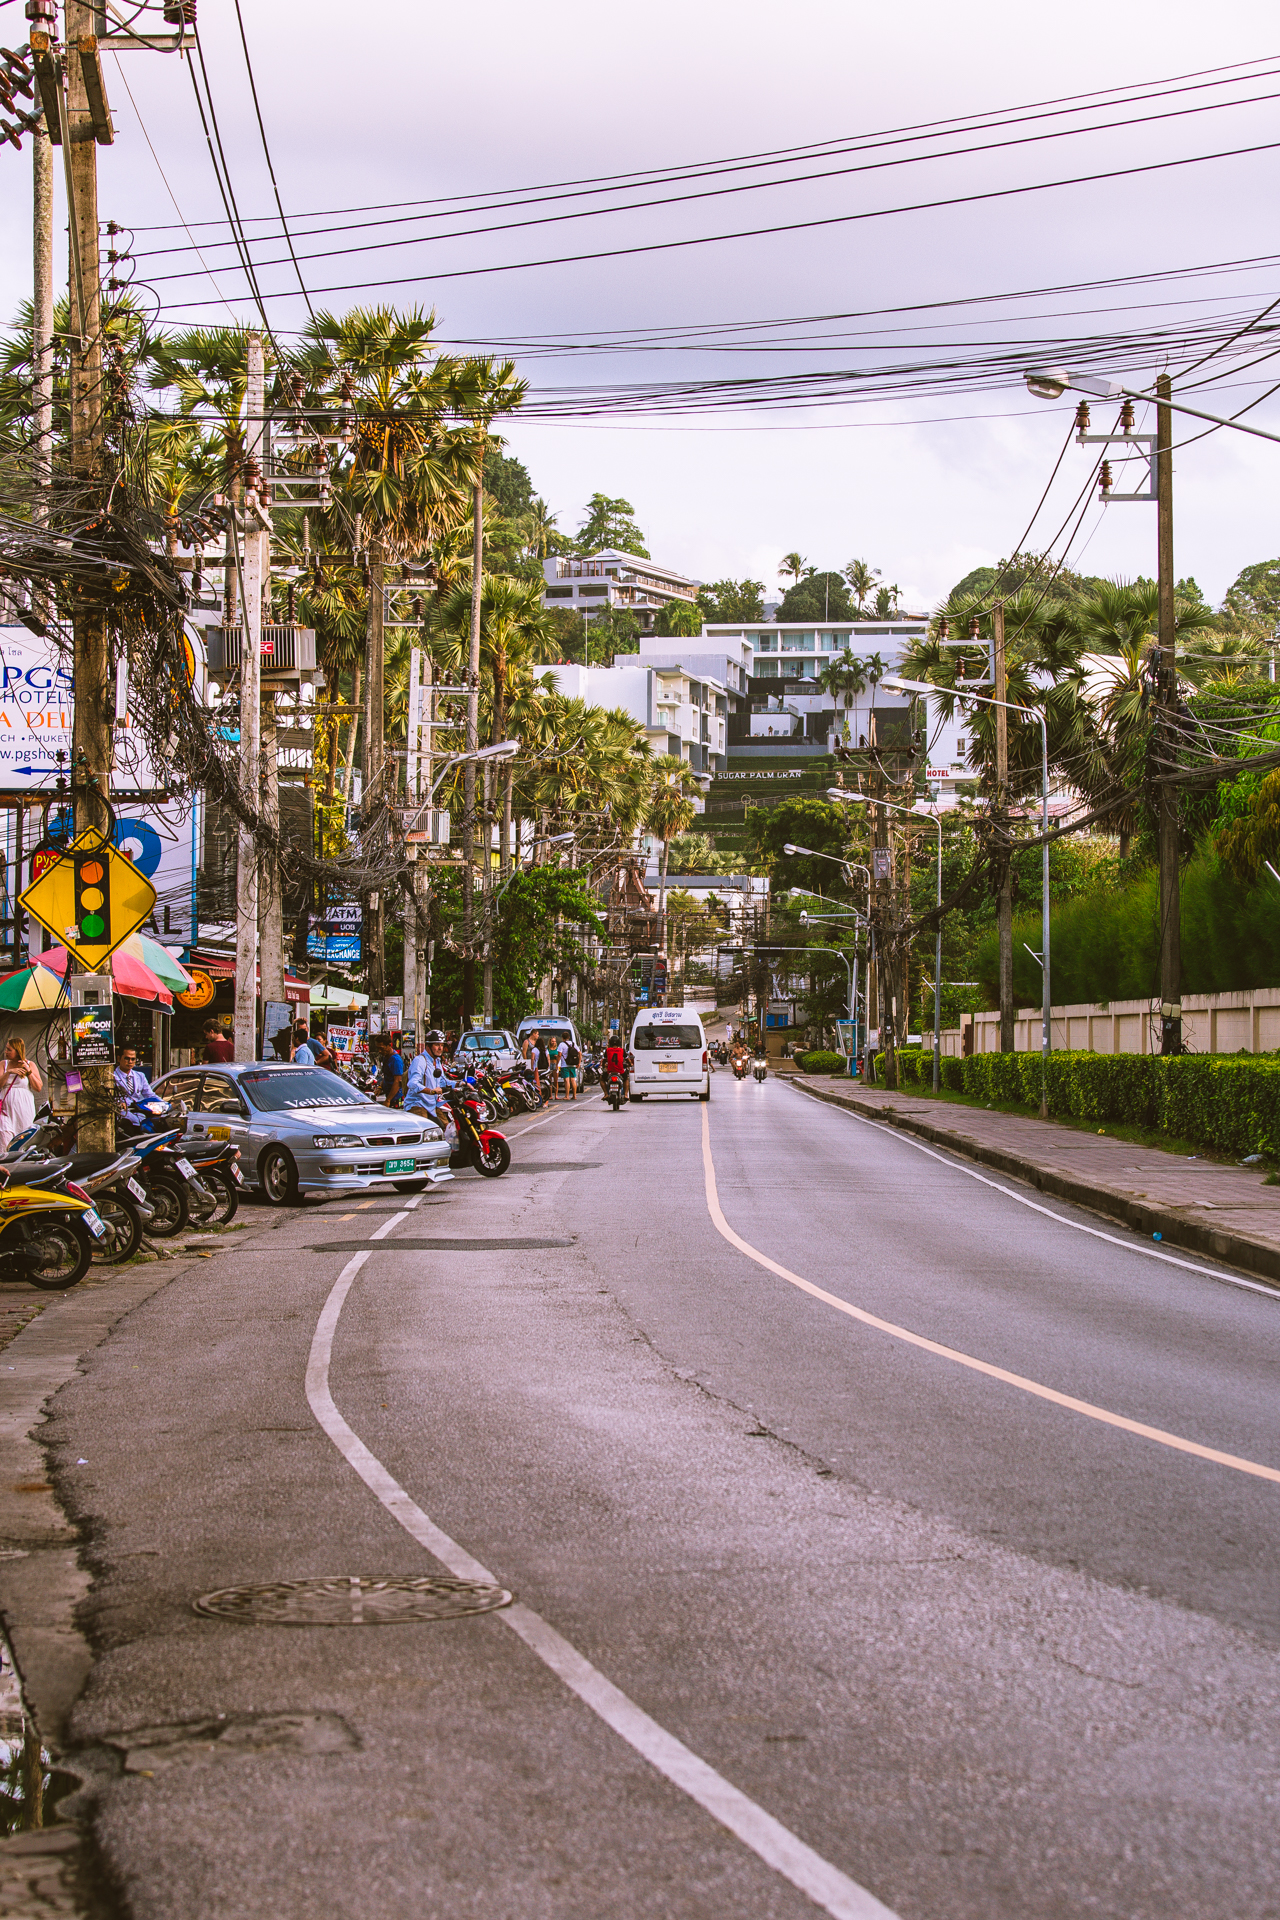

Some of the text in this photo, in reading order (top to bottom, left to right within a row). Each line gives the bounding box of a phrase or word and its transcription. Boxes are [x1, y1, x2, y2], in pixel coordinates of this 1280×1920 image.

[2, 666, 75, 689] PGS
[3, 690, 75, 704] HOTELS
[26, 711, 73, 728] DEL
[28, 734, 69, 742] PHUKET
[717, 772, 746, 780] SUGAR
[749, 771, 774, 779] PALM
[331, 909, 357, 919] ATM
[340, 923, 356, 931] UOB
[326, 948, 361, 960] EXCHANGE
[611, 1053, 619, 1066] 4
[283, 1096, 355, 1108] VeilSide
